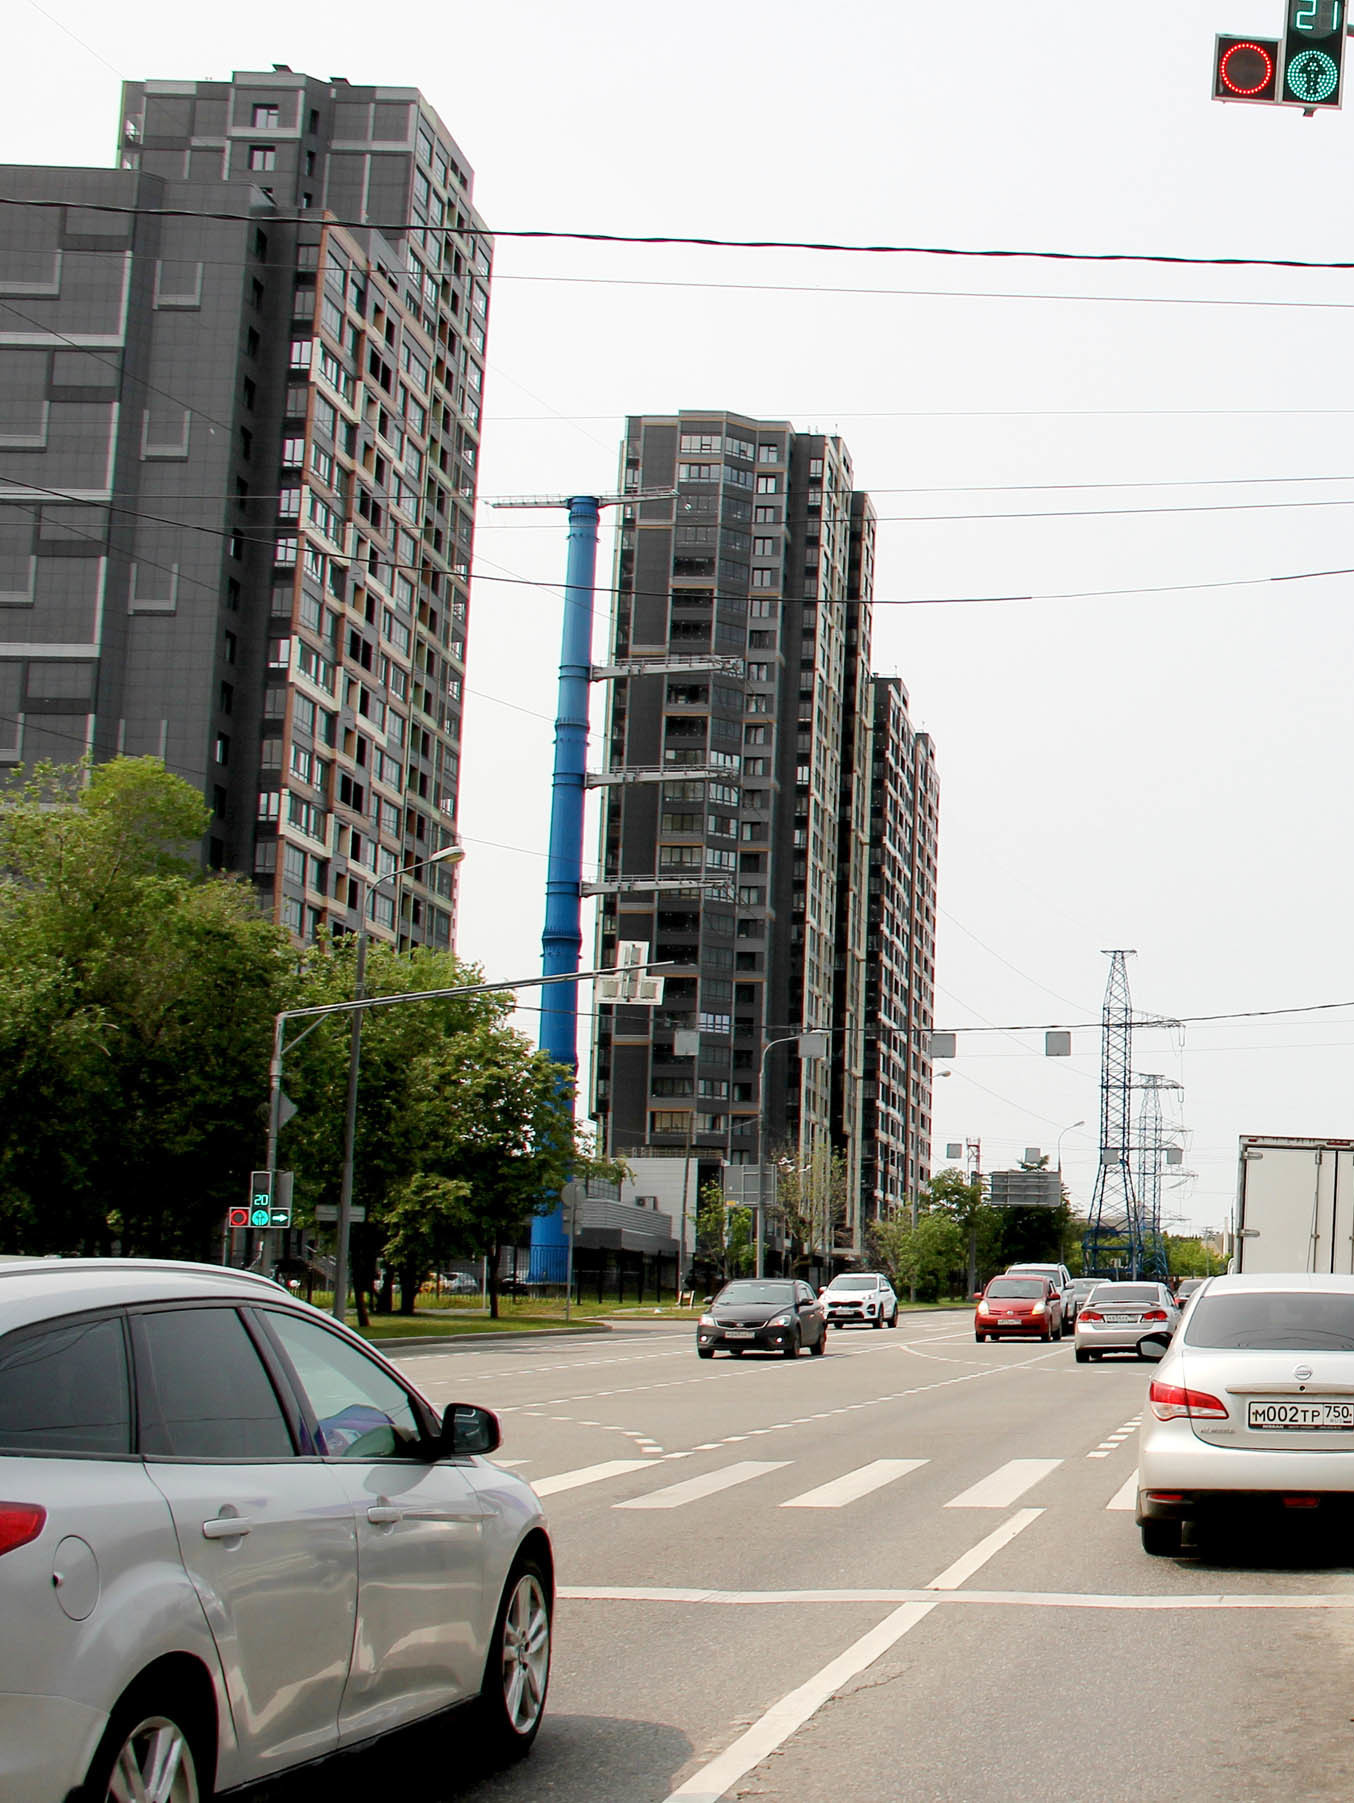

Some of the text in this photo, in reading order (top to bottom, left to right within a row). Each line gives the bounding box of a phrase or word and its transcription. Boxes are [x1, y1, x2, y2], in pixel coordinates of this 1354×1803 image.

[1296, 0, 1338, 30] 21
[253, 1194, 269, 1206] 20
[1324, 1405, 1350, 1419] 750
